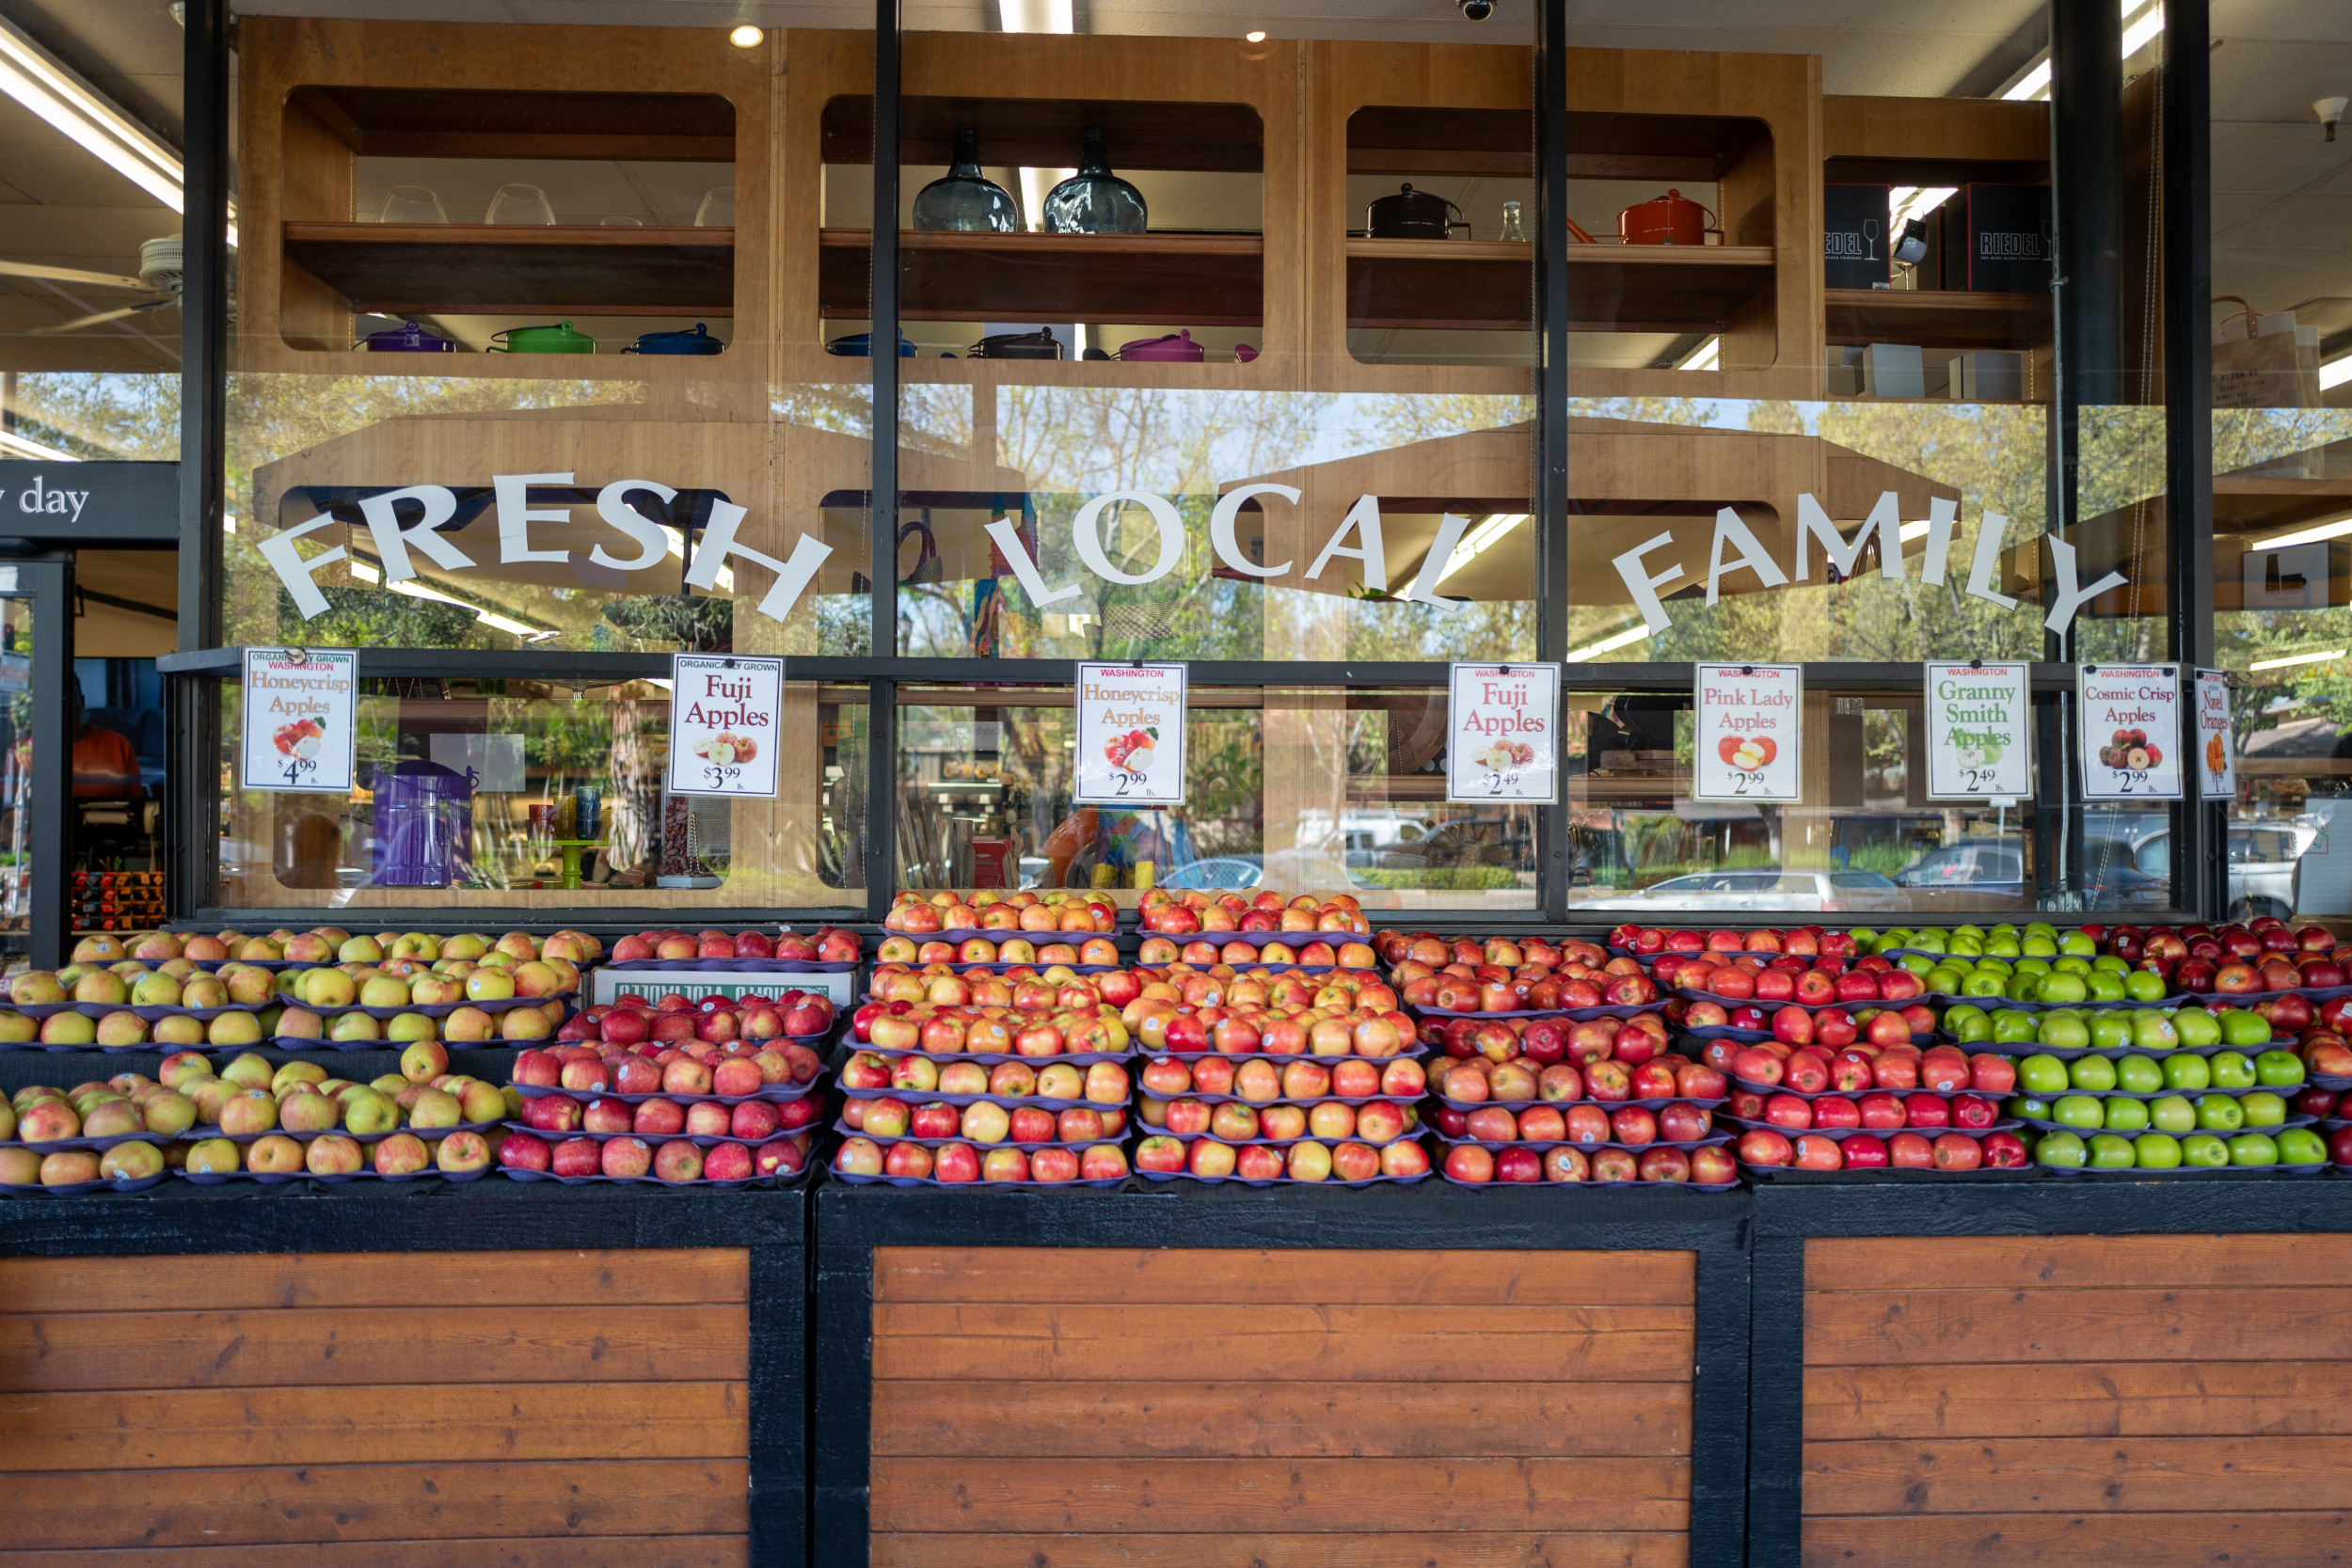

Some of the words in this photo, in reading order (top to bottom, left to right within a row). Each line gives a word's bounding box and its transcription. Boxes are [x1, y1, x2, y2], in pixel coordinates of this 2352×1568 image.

[1980, 232, 2040, 255] RIEDEL
[20, 475, 89, 523] day
[256, 472, 834, 623] FRESH
[984, 483, 1471, 611] LOCAL
[1612, 490, 2129, 637] FAMILY
[316, 655, 350, 664] GROWN
[743, 662, 778, 672] GROWN
[251, 671, 350, 694] Honeycrisp
[1101, 669, 1164, 678] WASHINGTON
[1947, 668, 2008, 676] WASHINGTON
[2100, 670, 2160, 678] WASHINGTON
[705, 674, 753, 704] Fuji
[1083, 683, 1180, 705] Honeycrisp
[1482, 682, 1529, 709] Fuji
[1704, 688, 1746, 705] Pink
[1750, 689, 1794, 709] Lady
[1938, 680, 2016, 705] Granny
[2085, 686, 2136, 701] Cosmic
[2138, 686, 2175, 703] Crisp
[268, 695, 330, 717] Apples
[2203, 690, 2223, 711] Navel
[684, 701, 769, 730] Apples
[1101, 707, 1161, 728] Apples
[1462, 708, 1545, 736] Apples
[1719, 711, 1777, 732] Apples
[1946, 702, 2009, 723] Smith
[2105, 706, 2156, 725] Apples
[2201, 710, 2229, 734] Oranges
[1944, 725, 2011, 751] Apples
